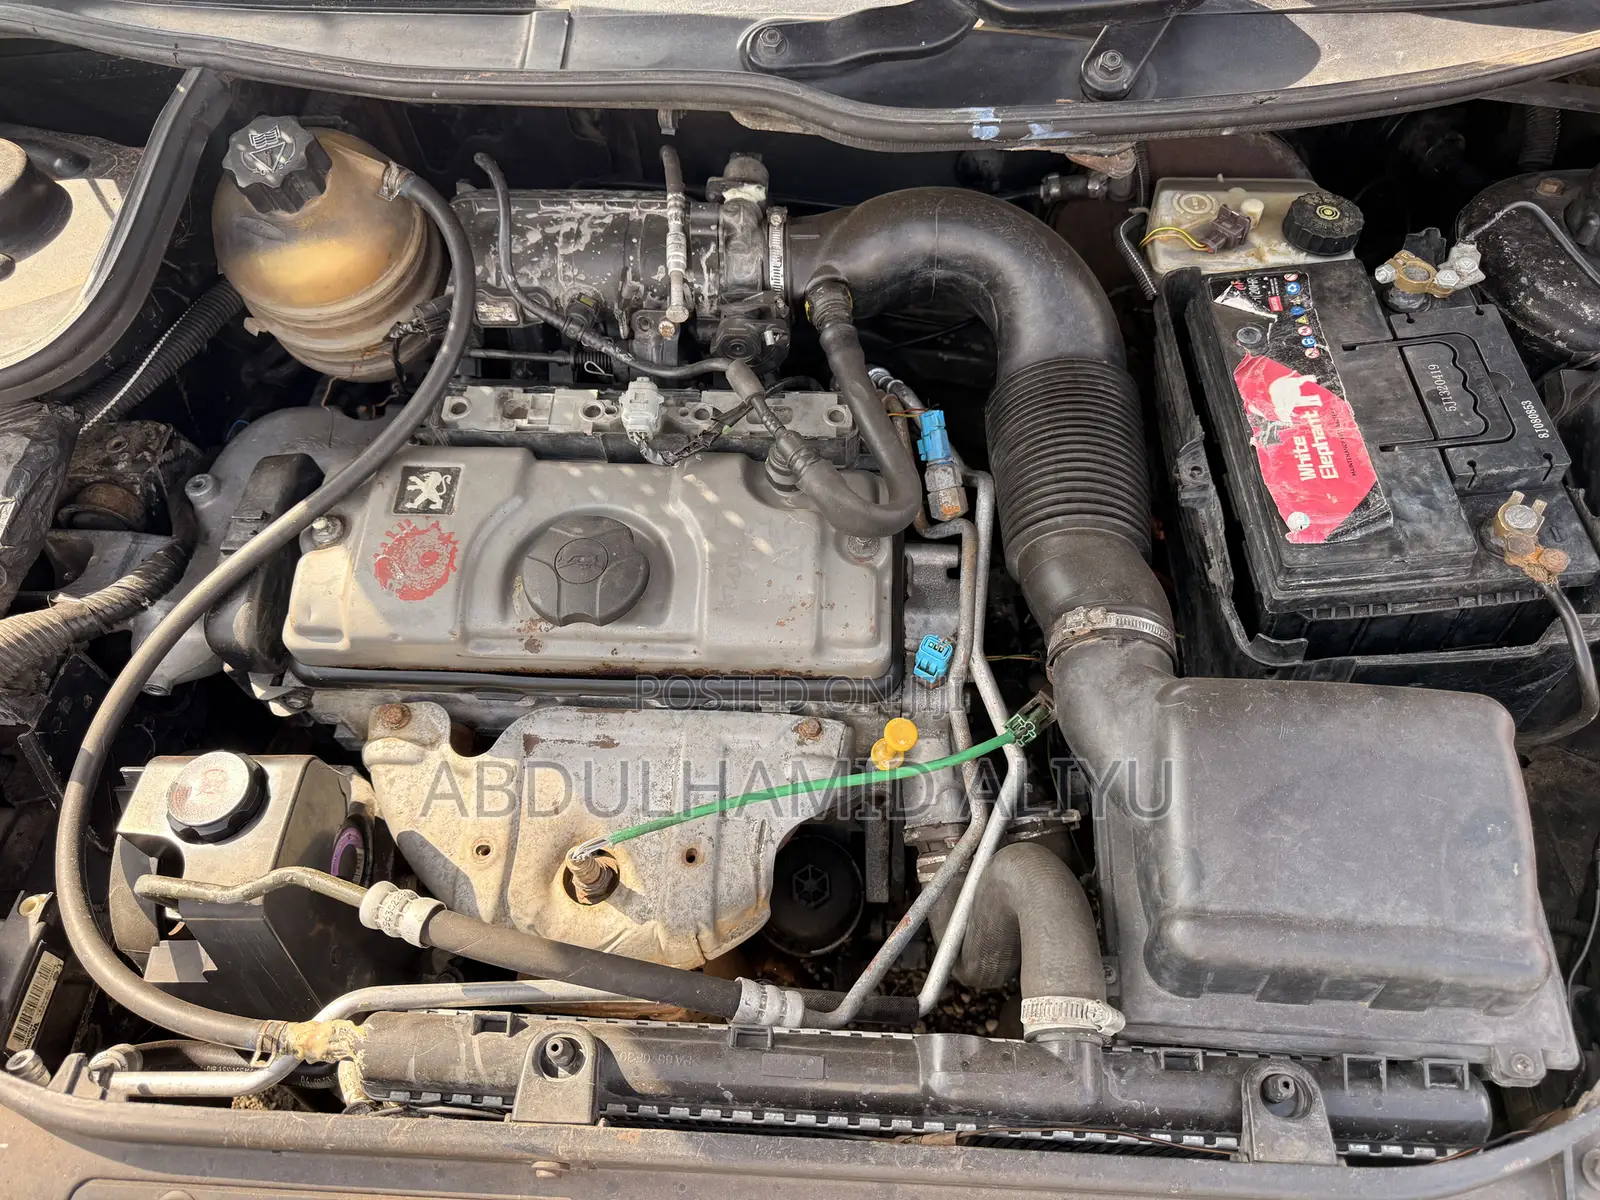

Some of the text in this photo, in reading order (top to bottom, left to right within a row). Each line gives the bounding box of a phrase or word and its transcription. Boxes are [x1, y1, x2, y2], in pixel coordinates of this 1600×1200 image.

[1427, 364, 1458, 412] 5J1320419
[1521, 400, 1550, 439] 8J080853
[1292, 435, 1317, 481] White
[1301, 409, 1339, 480] Elephant
